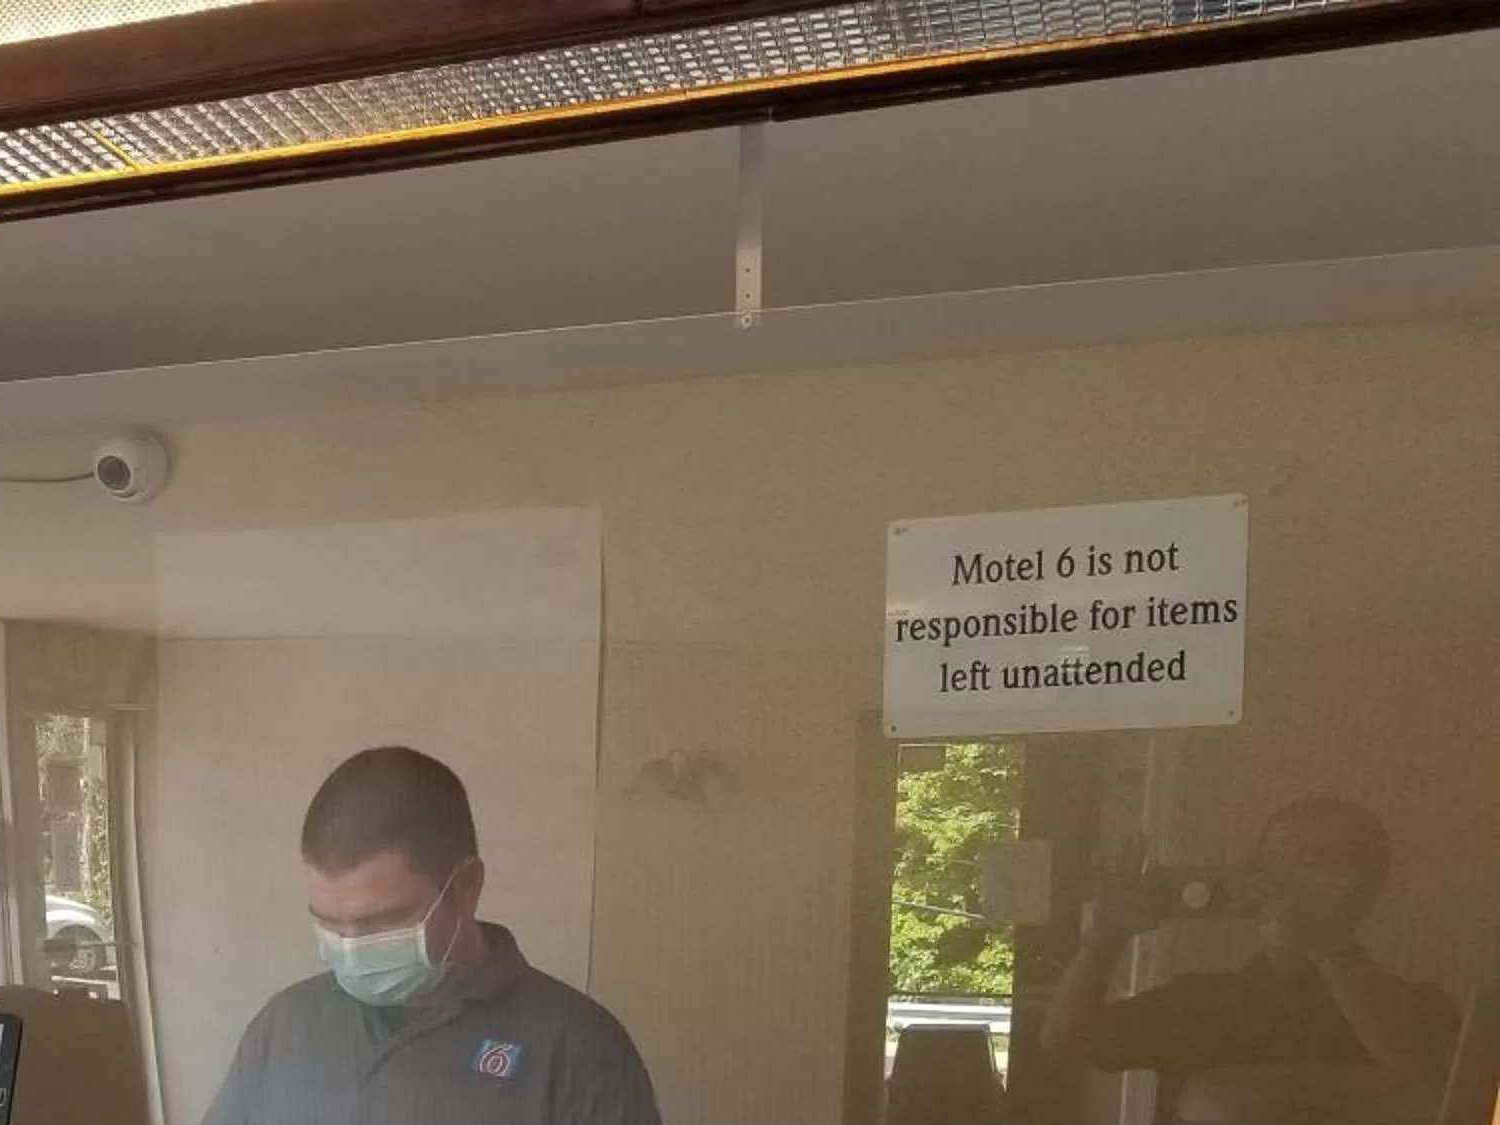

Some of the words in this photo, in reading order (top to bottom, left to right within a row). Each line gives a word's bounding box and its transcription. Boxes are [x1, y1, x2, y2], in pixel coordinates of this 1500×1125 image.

[951, 550, 1044, 586] Motel
[1056, 546, 1076, 579] 6
[1087, 545, 1113, 577] is
[1124, 542, 1181, 574] not
[895, 602, 1079, 648] responsible
[1089, 599, 1137, 632] for
[1146, 596, 1239, 628] items
[939, 659, 992, 693] left
[1001, 650, 1187, 690] unattended
